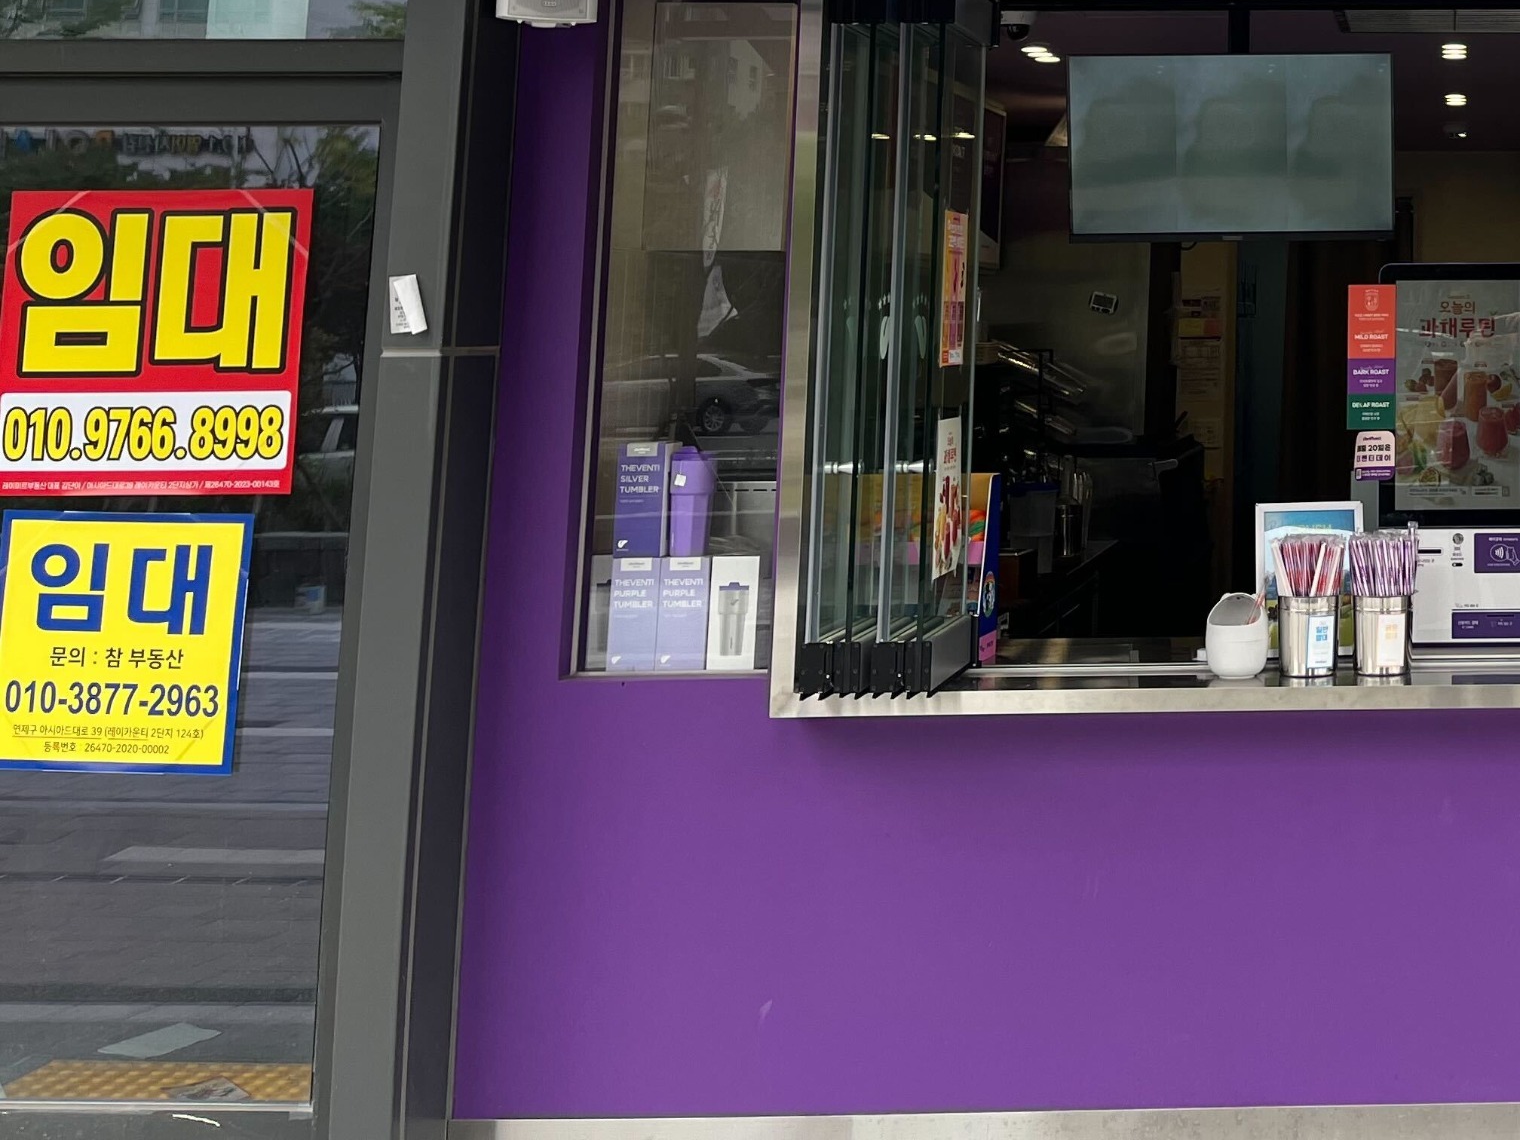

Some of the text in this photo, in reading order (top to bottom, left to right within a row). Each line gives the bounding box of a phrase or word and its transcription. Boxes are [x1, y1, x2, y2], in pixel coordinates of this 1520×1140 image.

[17, 208, 296, 376] 임대
[1439, 301, 1476, 315] 오늘의
[3, 405, 283, 461] 010.9766.8998
[620, 464, 660, 472] THEVENTI
[620, 475, 649, 483] SILVER
[620, 486, 660, 494] TUMBLER
[614, 578, 655, 587] THEVENTI
[664, 578, 704, 587] THEVENTI
[31, 543, 213, 635] 임대
[614, 589, 646, 597] PURPLE
[663, 589, 696, 597] PURPLE
[613, 600, 653, 608] TUMBLER
[662, 599, 702, 608] TUMBLER
[50, 647, 85, 668] 문의
[105, 647, 123, 668] 참
[128, 648, 184, 670] 부동산
[5, 680, 219, 718] 010-3877-2963
[13, 724, 38, 735] 연제구
[40, 725, 88, 736] 아시아드대로
[90, 726, 102, 736] 39
[151, 728, 174, 739] 2단지
[44, 742, 170, 754] 등록번호 26470-2020-00002
